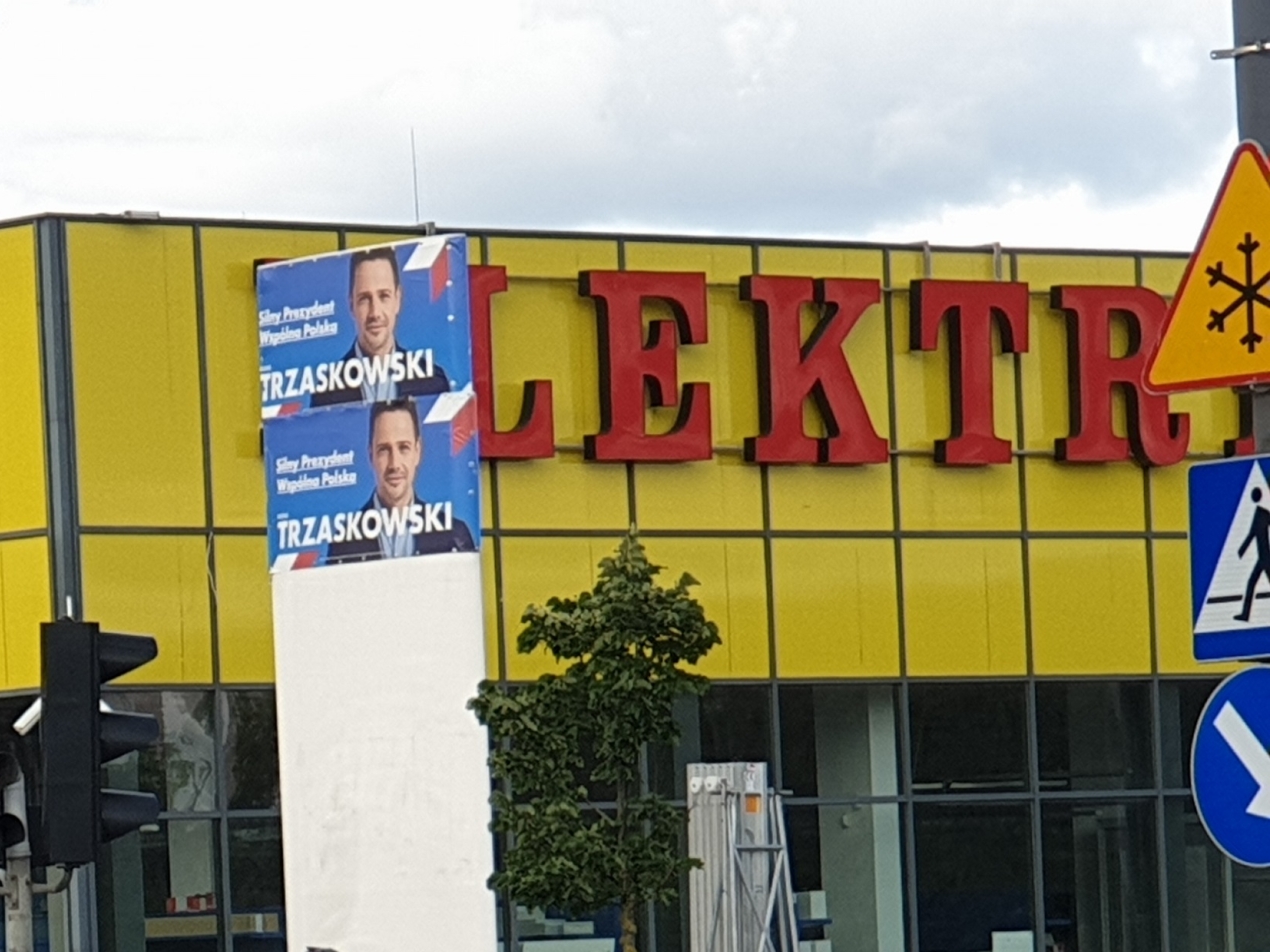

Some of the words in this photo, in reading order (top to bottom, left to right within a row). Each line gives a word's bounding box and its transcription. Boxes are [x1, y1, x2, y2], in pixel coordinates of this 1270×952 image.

[260, 348, 434, 402] TRZASKOWSKI
[468, 265, 1255, 467] LEKTR
[322, 468, 357, 487] Polska
[276, 501, 453, 550] TRZASKOWSKI
